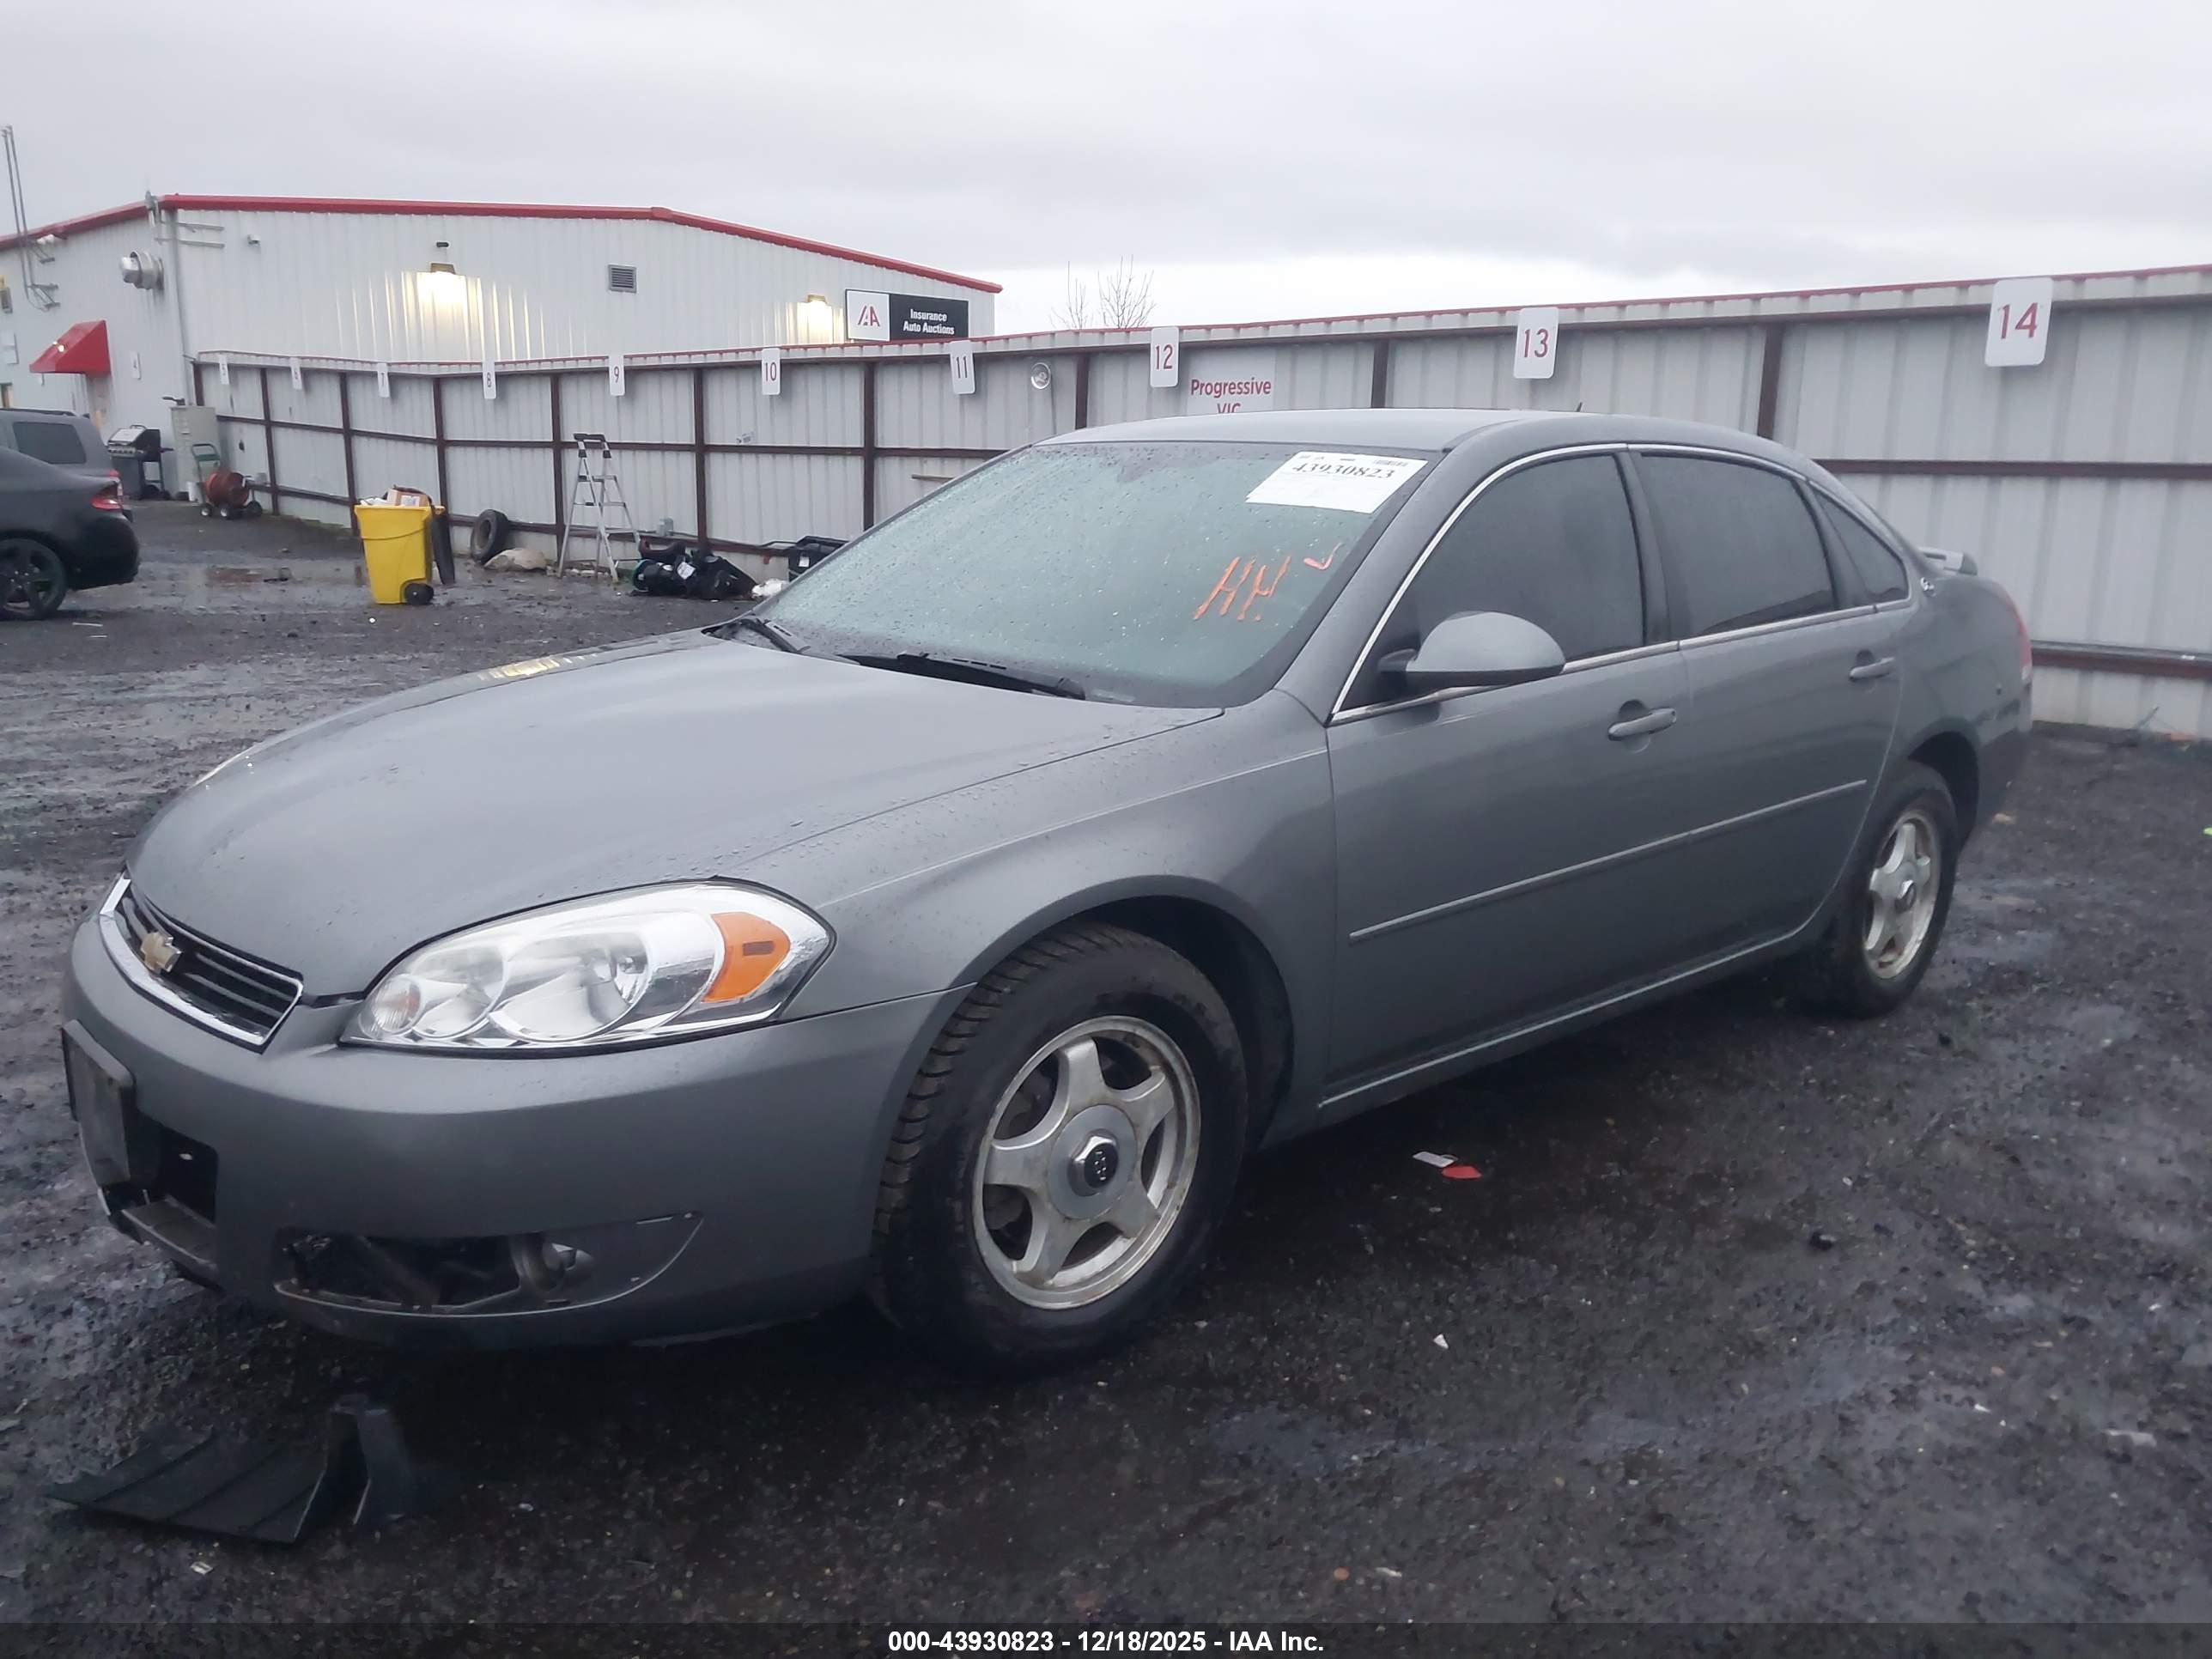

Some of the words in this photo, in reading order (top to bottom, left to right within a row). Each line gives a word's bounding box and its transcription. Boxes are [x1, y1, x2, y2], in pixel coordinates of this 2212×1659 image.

[910, 308, 947, 321] Insurance
[2000, 302, 2039, 339] 14
[903, 321, 921, 332] Auto
[922, 323, 955, 335] Auctions
[1524, 328, 1548, 357] 13
[1155, 344, 1173, 369] 12
[613, 366, 620, 383] 9
[765, 362, 777, 381] 10
[956, 356, 968, 379] 11
[486, 372, 492, 387] 8
[1191, 377, 1271, 398] Progressive
[1292, 463, 1395, 478] 43930823
